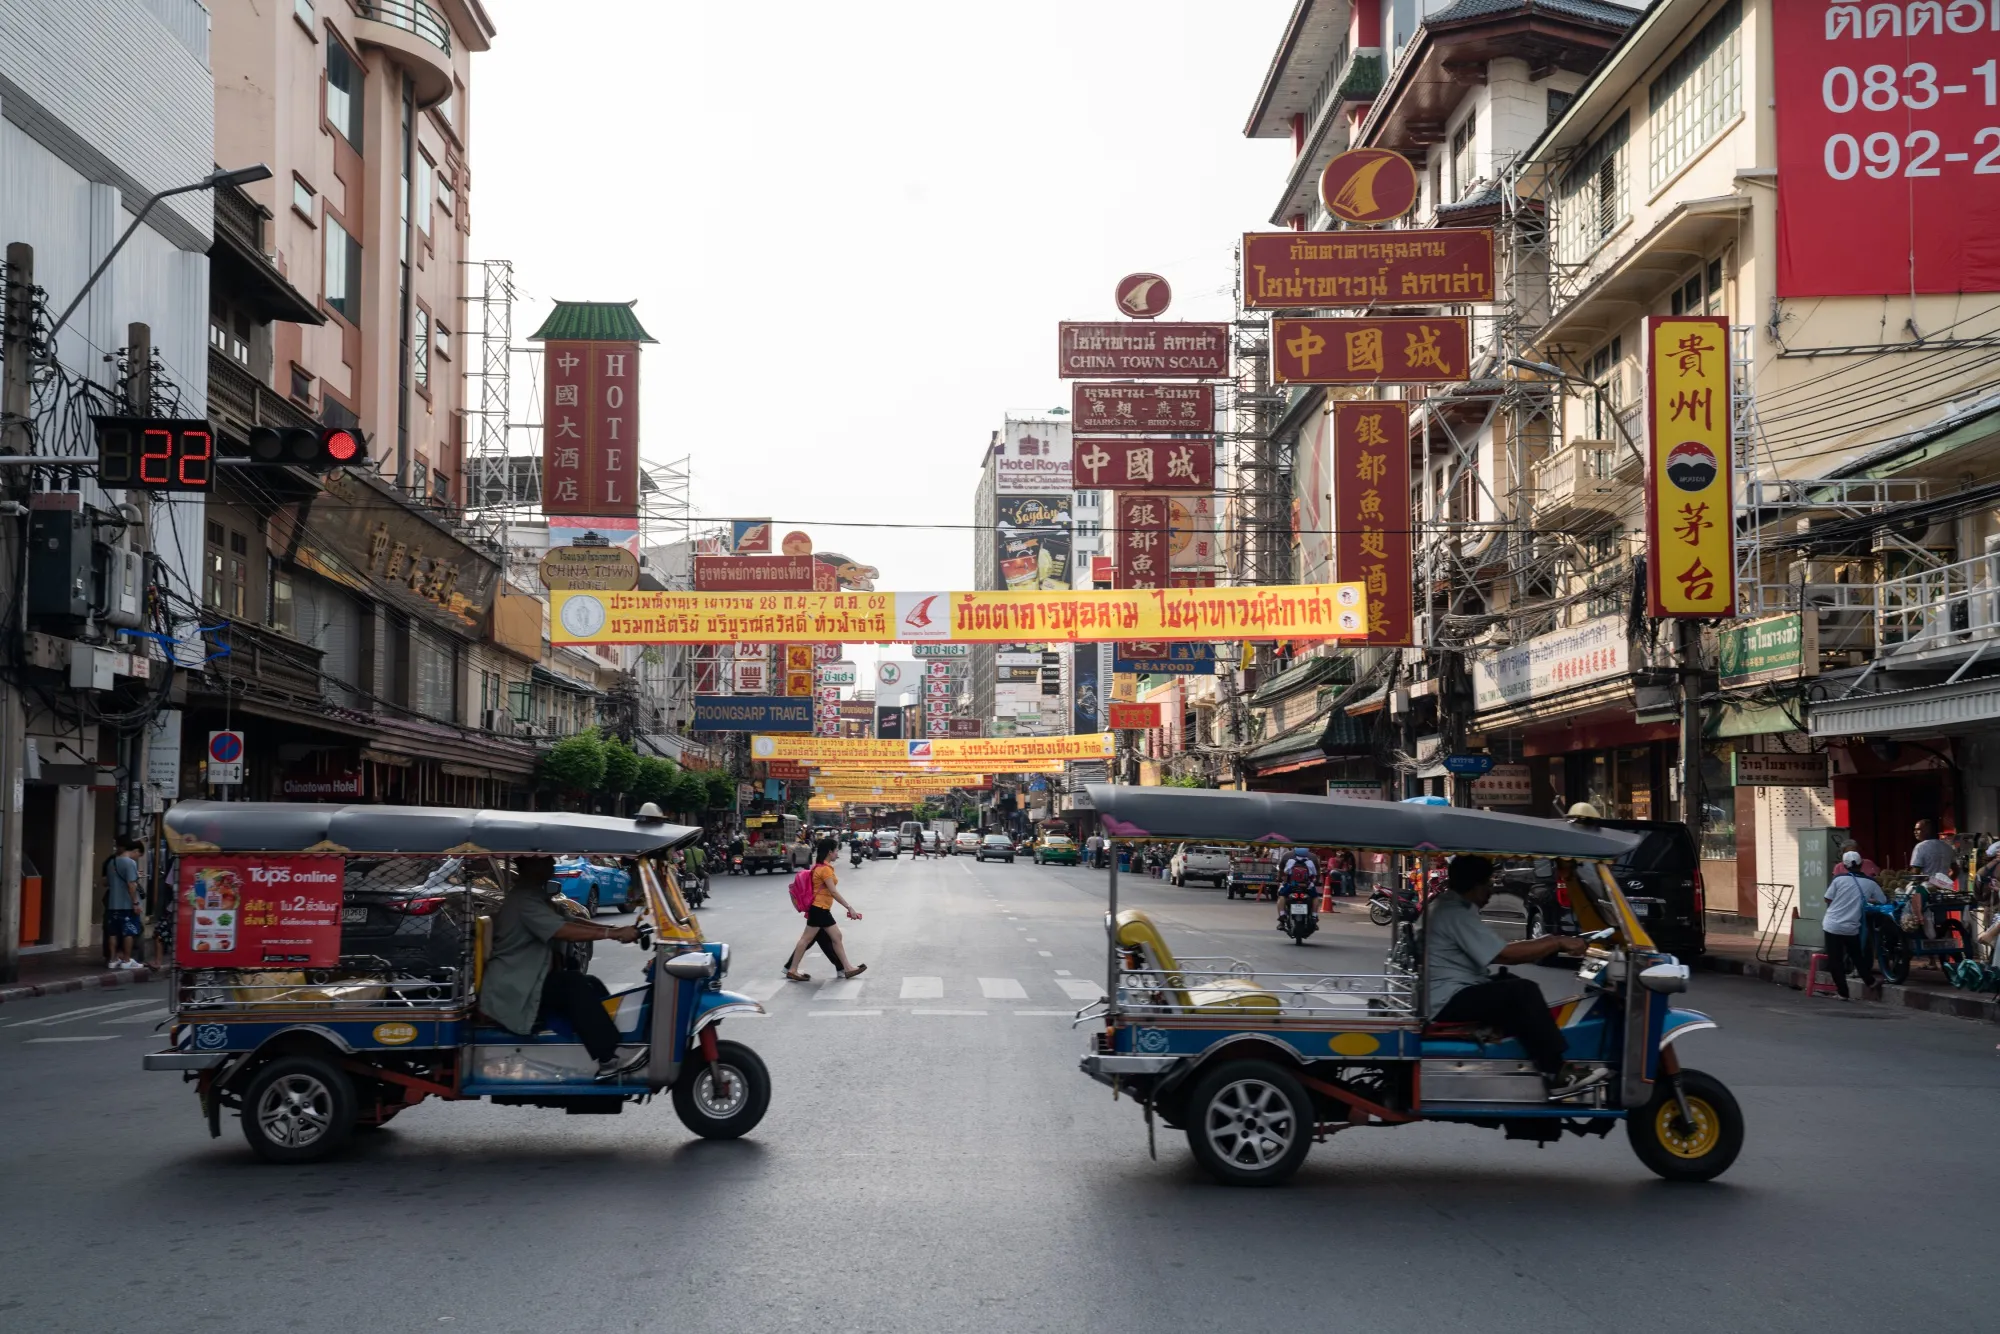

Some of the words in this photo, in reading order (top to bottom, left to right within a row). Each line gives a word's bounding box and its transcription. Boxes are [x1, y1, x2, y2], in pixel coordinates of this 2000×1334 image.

[1253, 265, 1388, 298] ไชน่าทาวน์
[1401, 264, 1485, 295] สกาล่า
[1286, 325, 1450, 377] 中國城
[1070, 355, 1115, 369] CHINA
[1120, 355, 1165, 369] TOWN
[1168, 355, 1219, 369] SCALA
[1665, 334, 1715, 431] 貴州
[553, 351, 581, 502] 中國大酒店
[605, 354, 626, 503] HOTEL
[1123, 418, 1138, 427] FIN
[1147, 418, 1177, 427] BIRD'S
[1179, 418, 1202, 427] NEST
[140, 429, 211, 485] 22
[1081, 444, 1200, 485] 中國城
[1000, 458, 1035, 471] Hotel
[1036, 459, 1073, 473] Royal
[1673, 501, 1714, 600] 茅台
[546, 564, 589, 578] CHINA
[595, 565, 634, 578] TOWN
[568, 581, 611, 590] HOTEL
[759, 595, 777, 610] 28
[868, 595, 886, 609] 62
[1133, 662, 1195, 672] SEAFOOD
[697, 706, 766, 721] ROONGSARP
[769, 706, 810, 721] TRAVEL
[1480, 758, 1488, 768] 2
[284, 779, 331, 793] Chinatown
[332, 779, 358, 793] Hotel
[247, 867, 291, 887] Tops
[293, 870, 337, 883] online
[293, 896, 306, 911] 2
